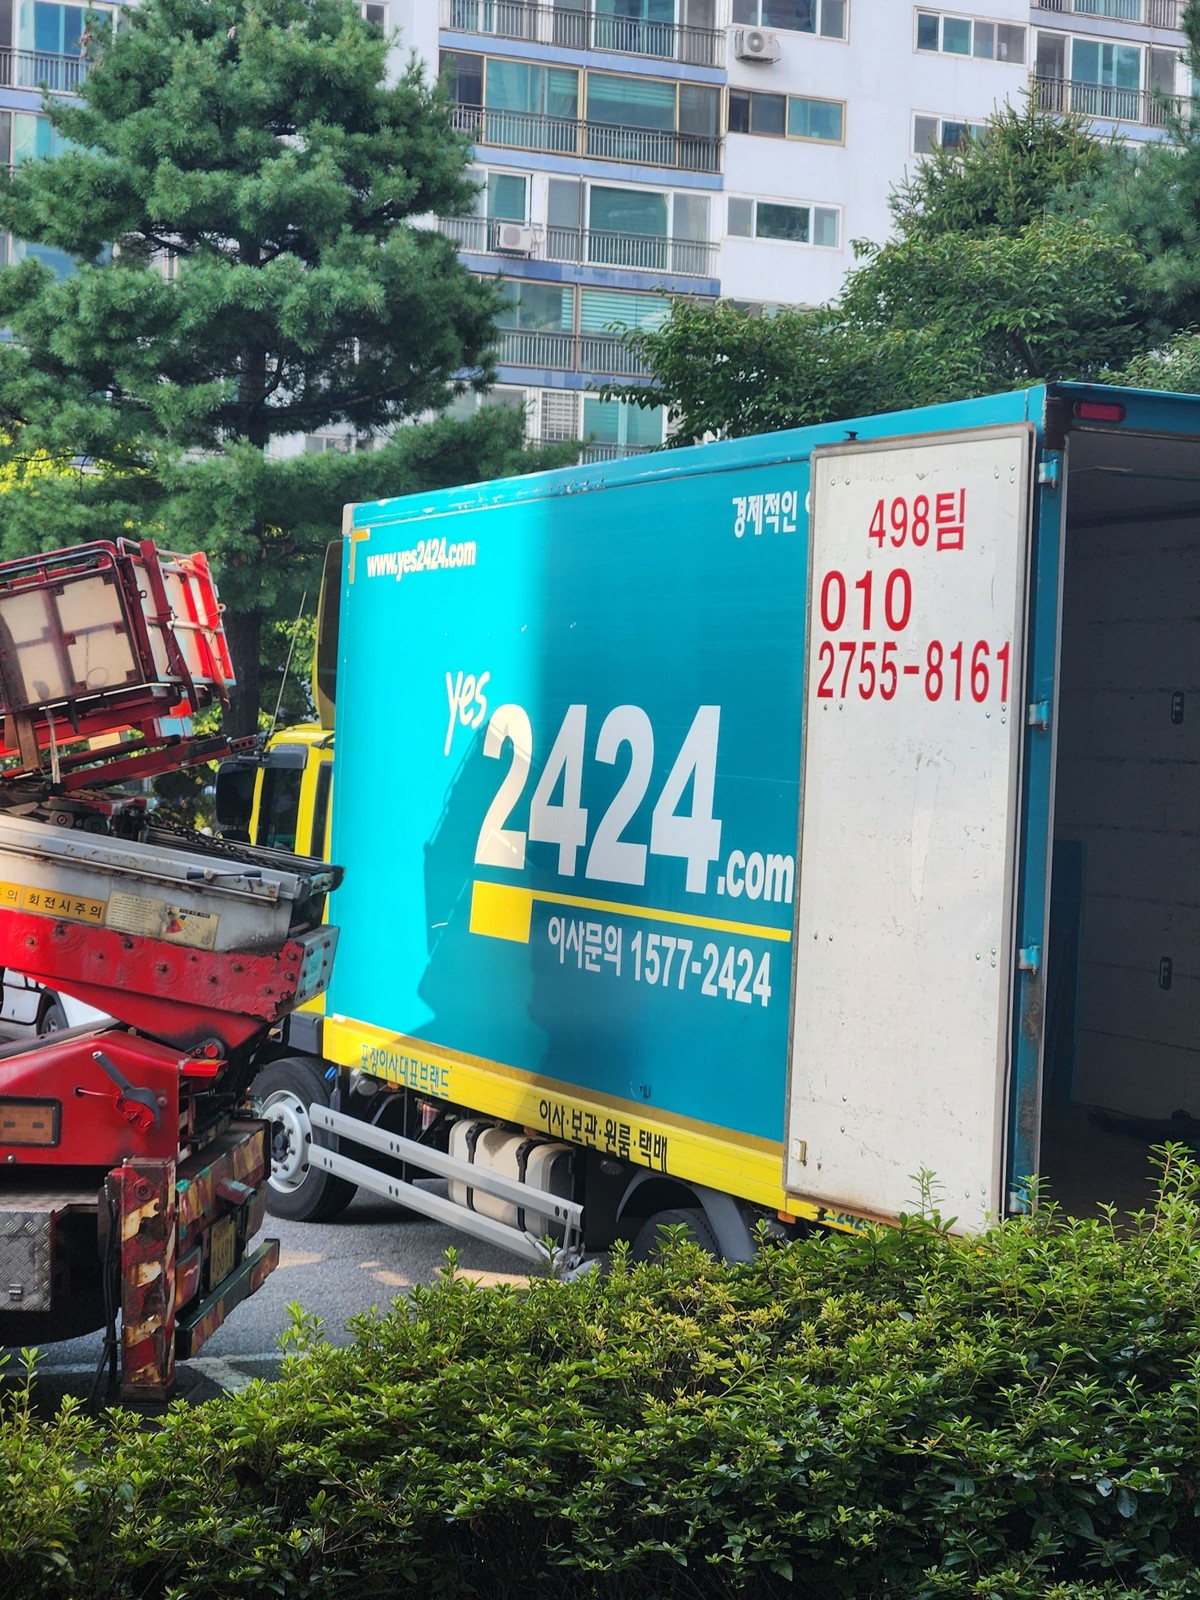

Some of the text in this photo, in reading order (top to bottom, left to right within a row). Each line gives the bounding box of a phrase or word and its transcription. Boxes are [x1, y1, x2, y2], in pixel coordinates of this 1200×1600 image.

[732, 490, 798, 538] 경제적인
[869, 488, 966, 551] 498팀
[366, 536, 477, 582] www.yes2424.com
[820, 568, 912, 632] 010
[817, 640, 1011, 703] 2755-8161
[548, 916, 772, 1007] 이사문의 1577-2424
